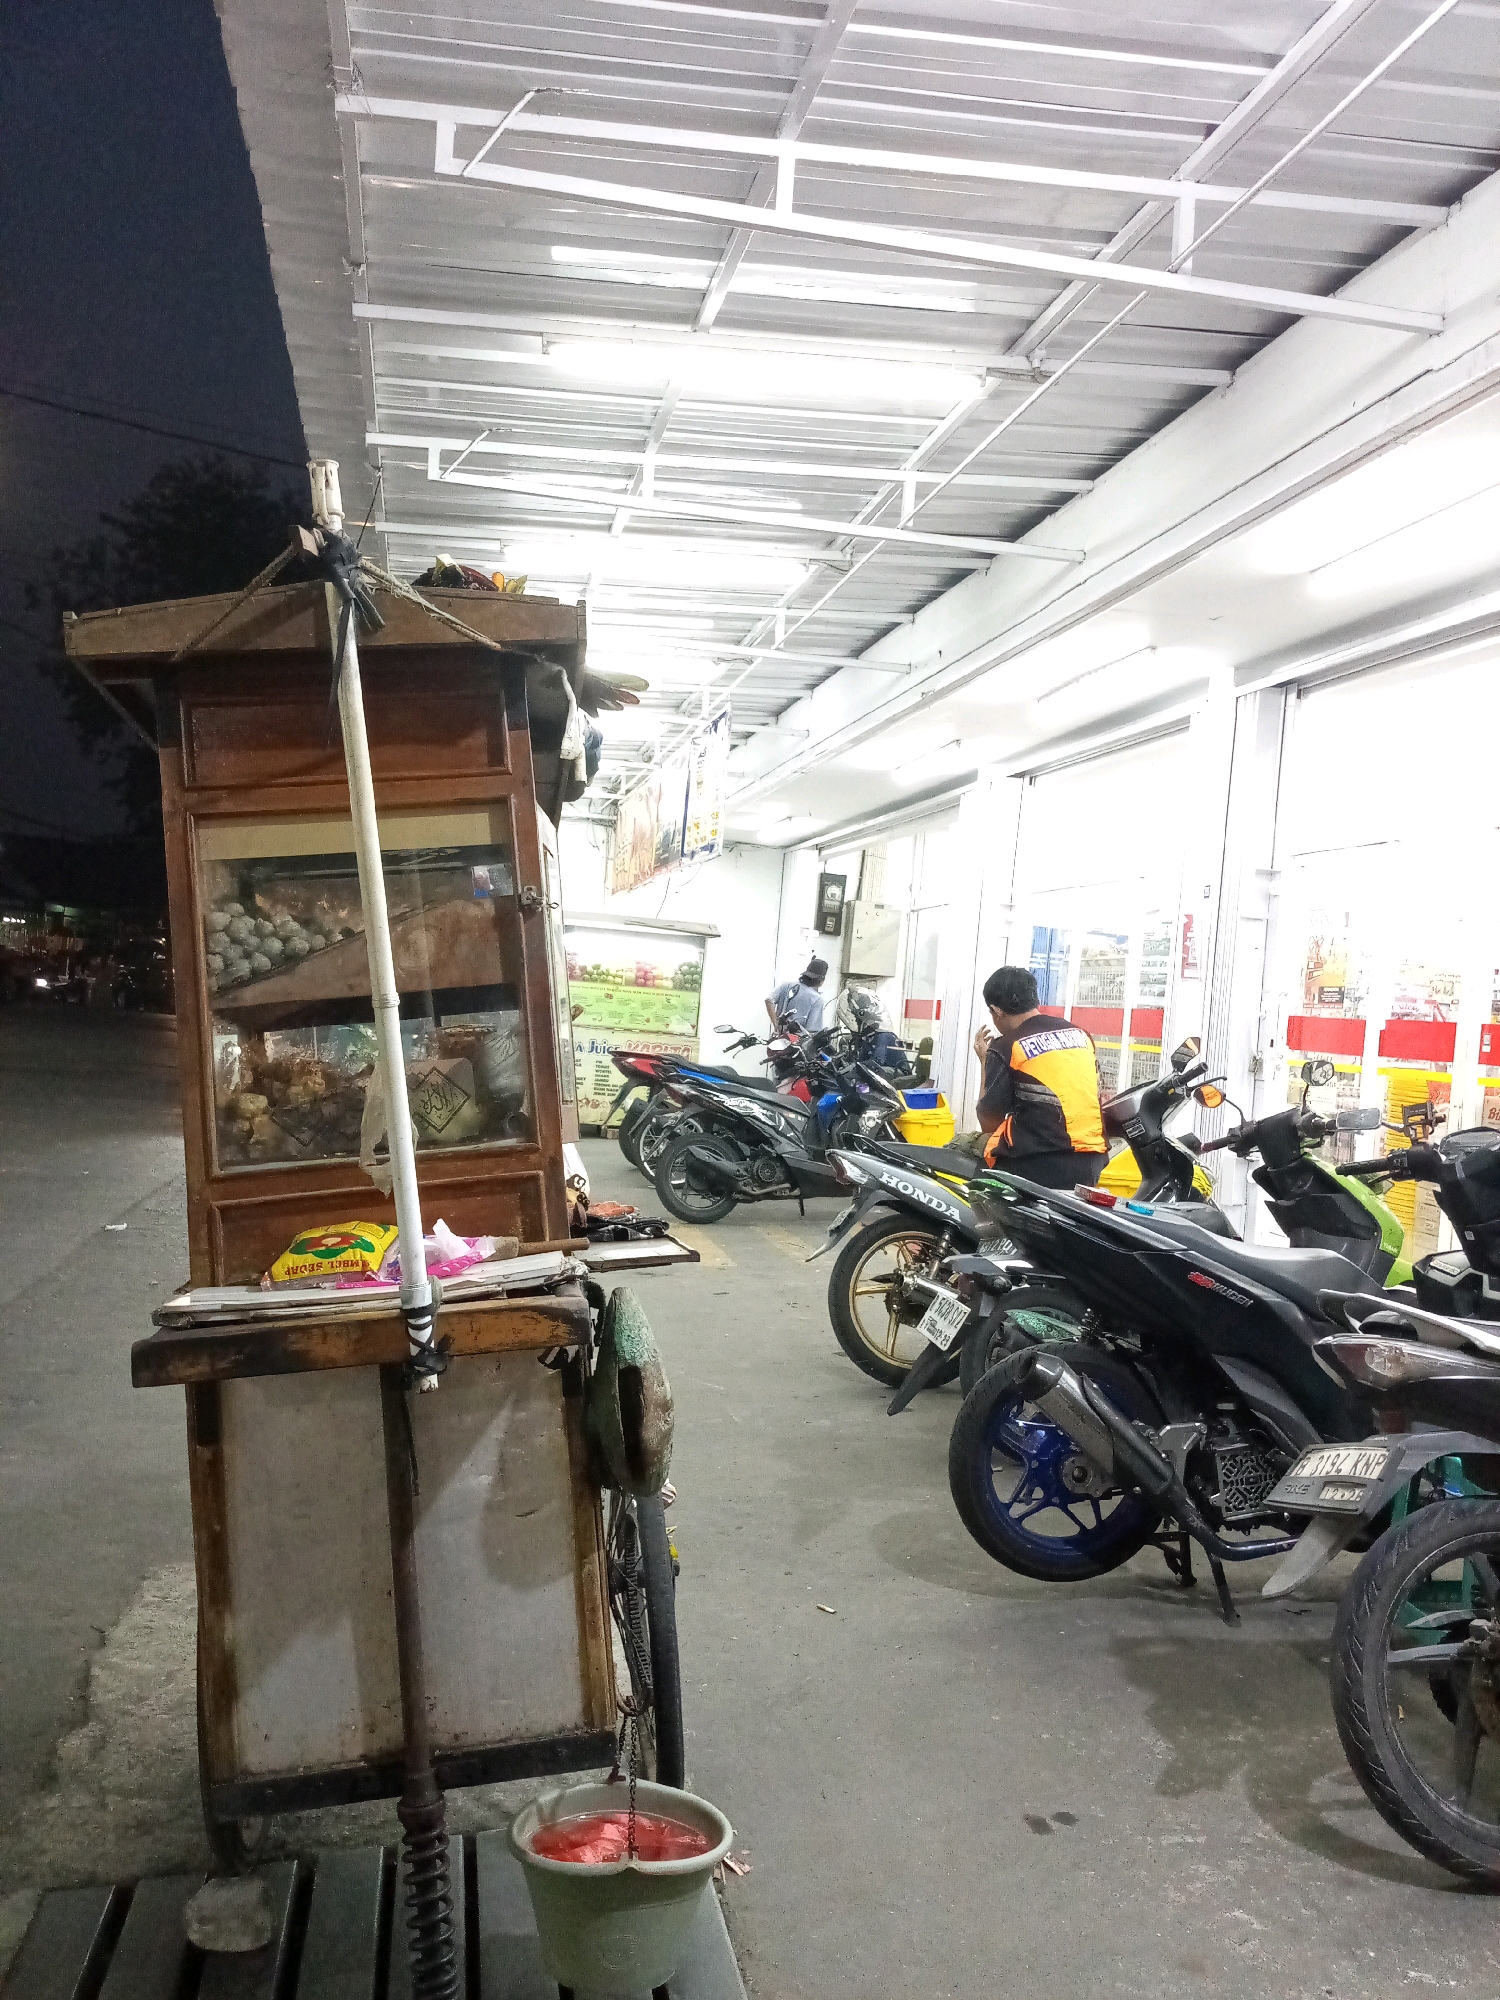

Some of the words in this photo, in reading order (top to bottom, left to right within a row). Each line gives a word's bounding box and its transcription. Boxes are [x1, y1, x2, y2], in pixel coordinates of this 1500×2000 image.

[879, 1171, 962, 1222] HONDA
[284, 1261, 323, 1276] SEDAP
[1349, 1451, 1389, 1476] KNP
